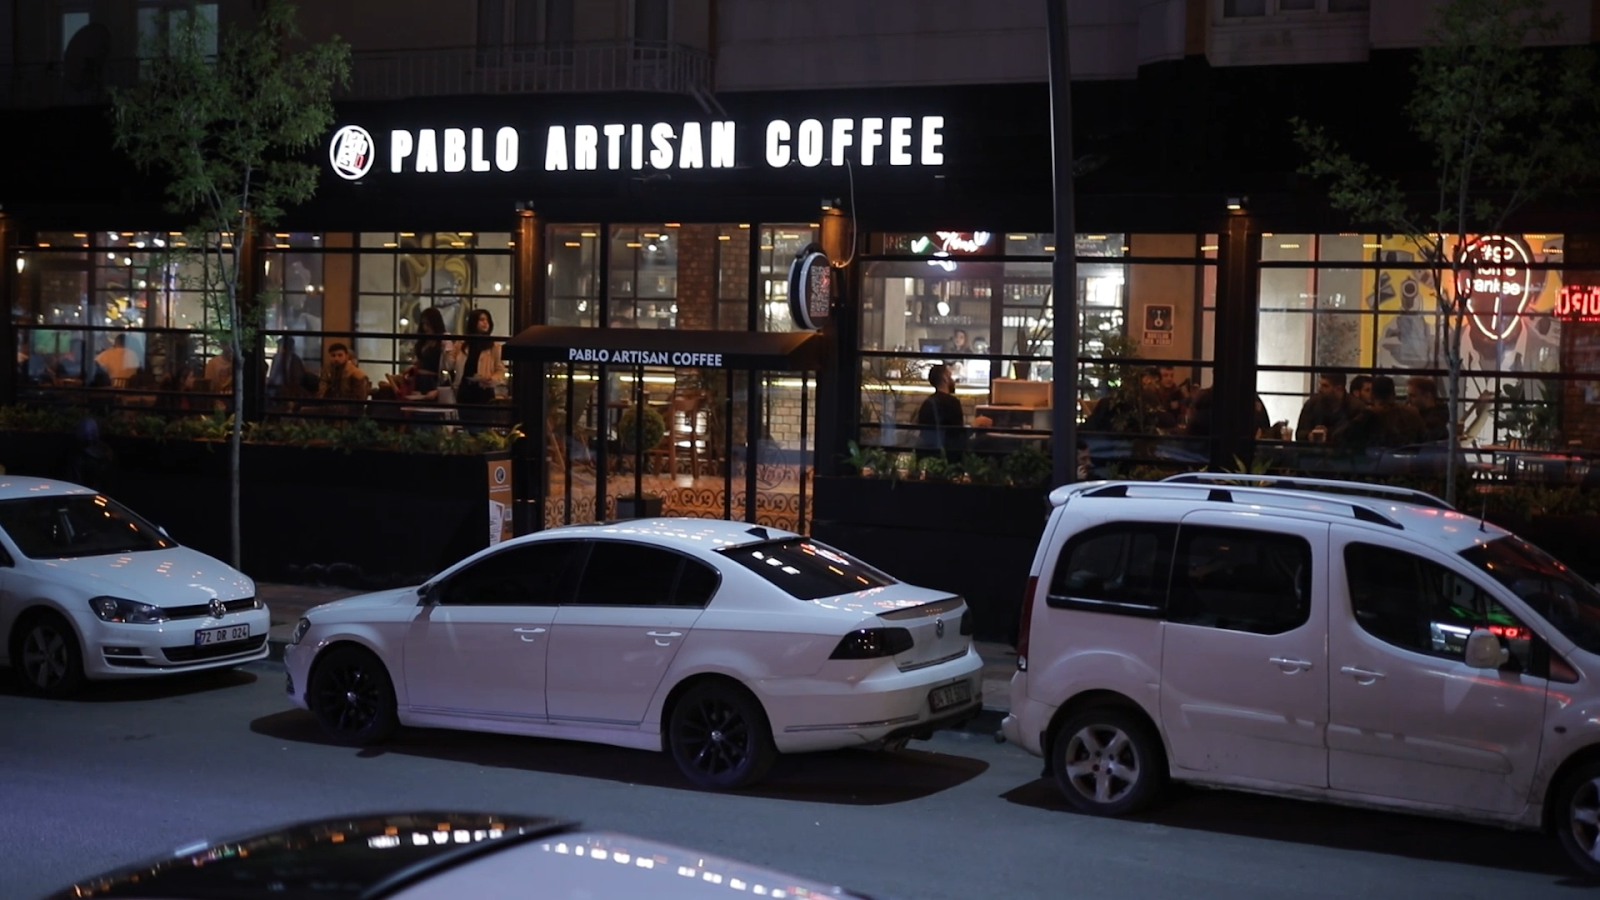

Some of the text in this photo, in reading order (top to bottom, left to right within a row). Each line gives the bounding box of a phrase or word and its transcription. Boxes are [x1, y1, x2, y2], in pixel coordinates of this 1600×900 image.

[391, 126, 519, 173] PABLO
[545, 122, 736, 171] ARTISAN
[765, 116, 945, 168] COFFEE
[569, 348, 723, 367] PABLO ARTISAN COFFEE
[232, 626, 247, 639] 024
